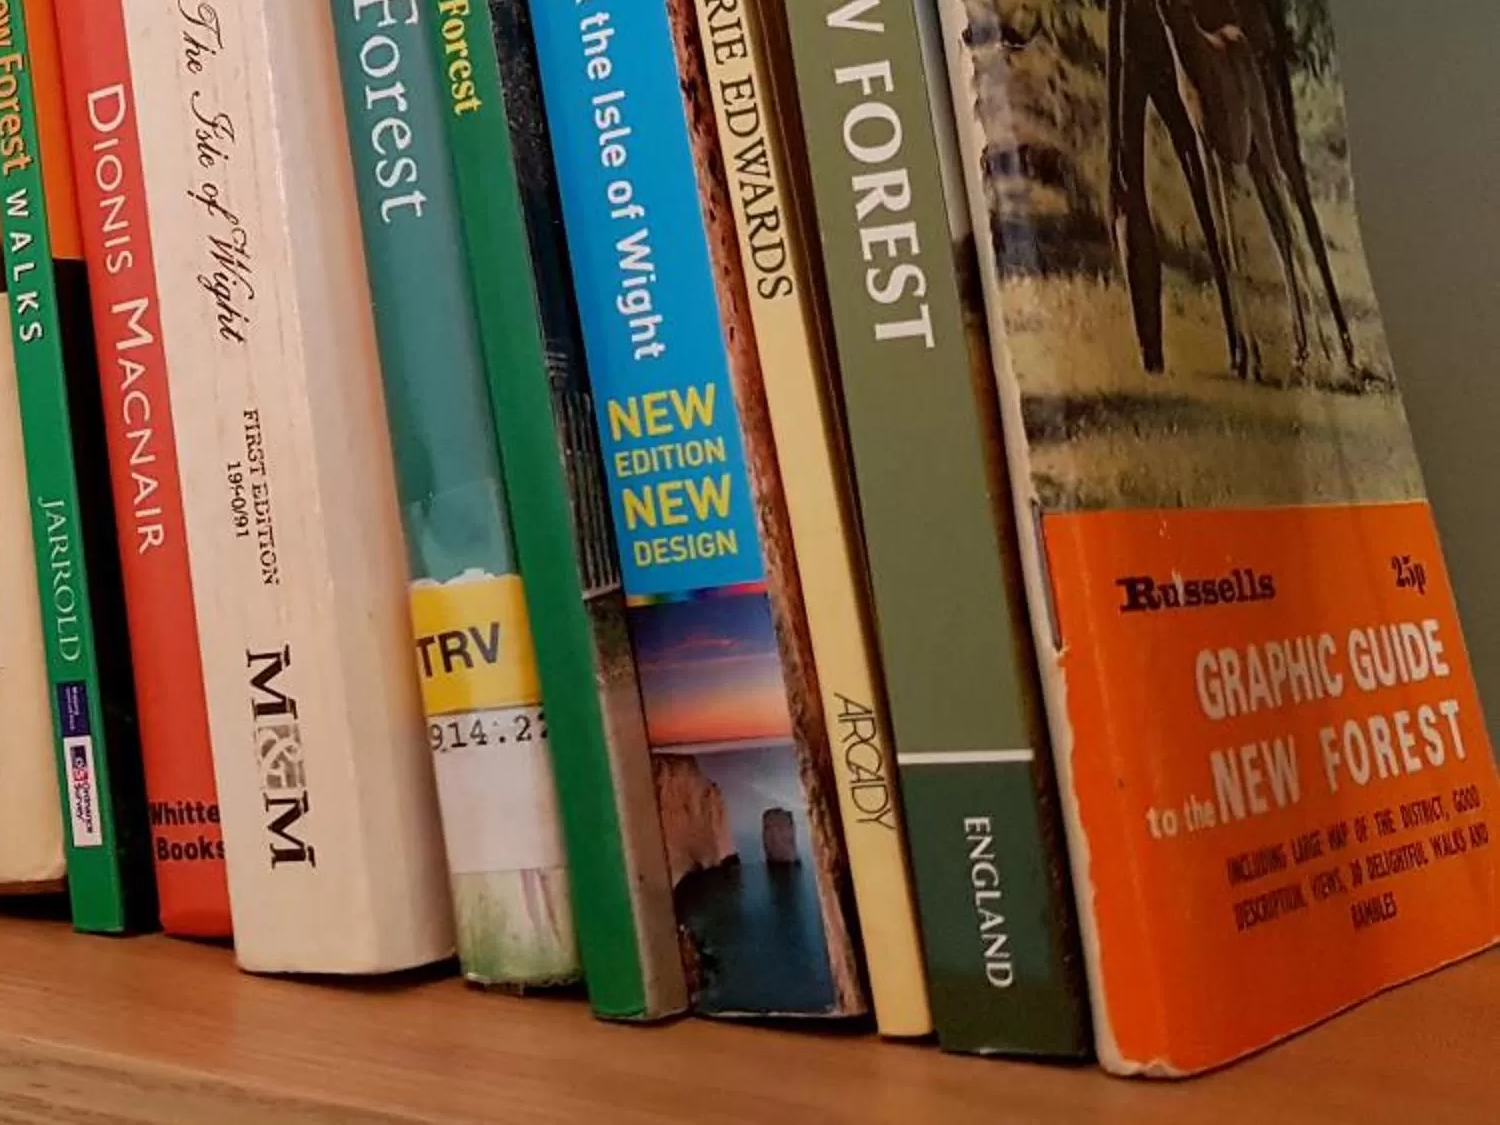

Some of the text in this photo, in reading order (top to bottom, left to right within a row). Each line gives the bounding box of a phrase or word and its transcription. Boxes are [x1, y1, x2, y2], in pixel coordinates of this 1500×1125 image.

[580, 11, 616, 81] the
[191, 90, 236, 168] Isle
[591, 89, 633, 168] Isle
[187, 181, 239, 226] of
[607, 179, 645, 220] of
[720, 74, 794, 300] EDWARDS
[834, 57, 935, 350] FOREST
[4, 187, 44, 344] WALKS
[197, 227, 255, 346] Wight
[615, 227, 667, 361] Wight
[86, 82, 166, 555] DIONIS MACNAIR
[607, 382, 716, 442] NEW
[614, 435, 727, 478] EDITION
[243, 408, 280, 586] FIRST EDITION
[622, 472, 732, 531] NEW
[37, 496, 81, 662] JARROLD
[633, 528, 739, 567] DESIGN
[1115, 554, 1427, 614] Russells 25p
[415, 621, 501, 679] TRV
[1194, 617, 1451, 721] GRAPHIC GUIDE
[1145, 698, 1468, 840] to the NEW FOREST
[156, 835, 226, 861] Books
[1373, 807, 1397, 839] THE
[1429, 830, 1468, 860] WALKS
[1468, 821, 1490, 851] AND
[963, 815, 1014, 989] ENGLAND
